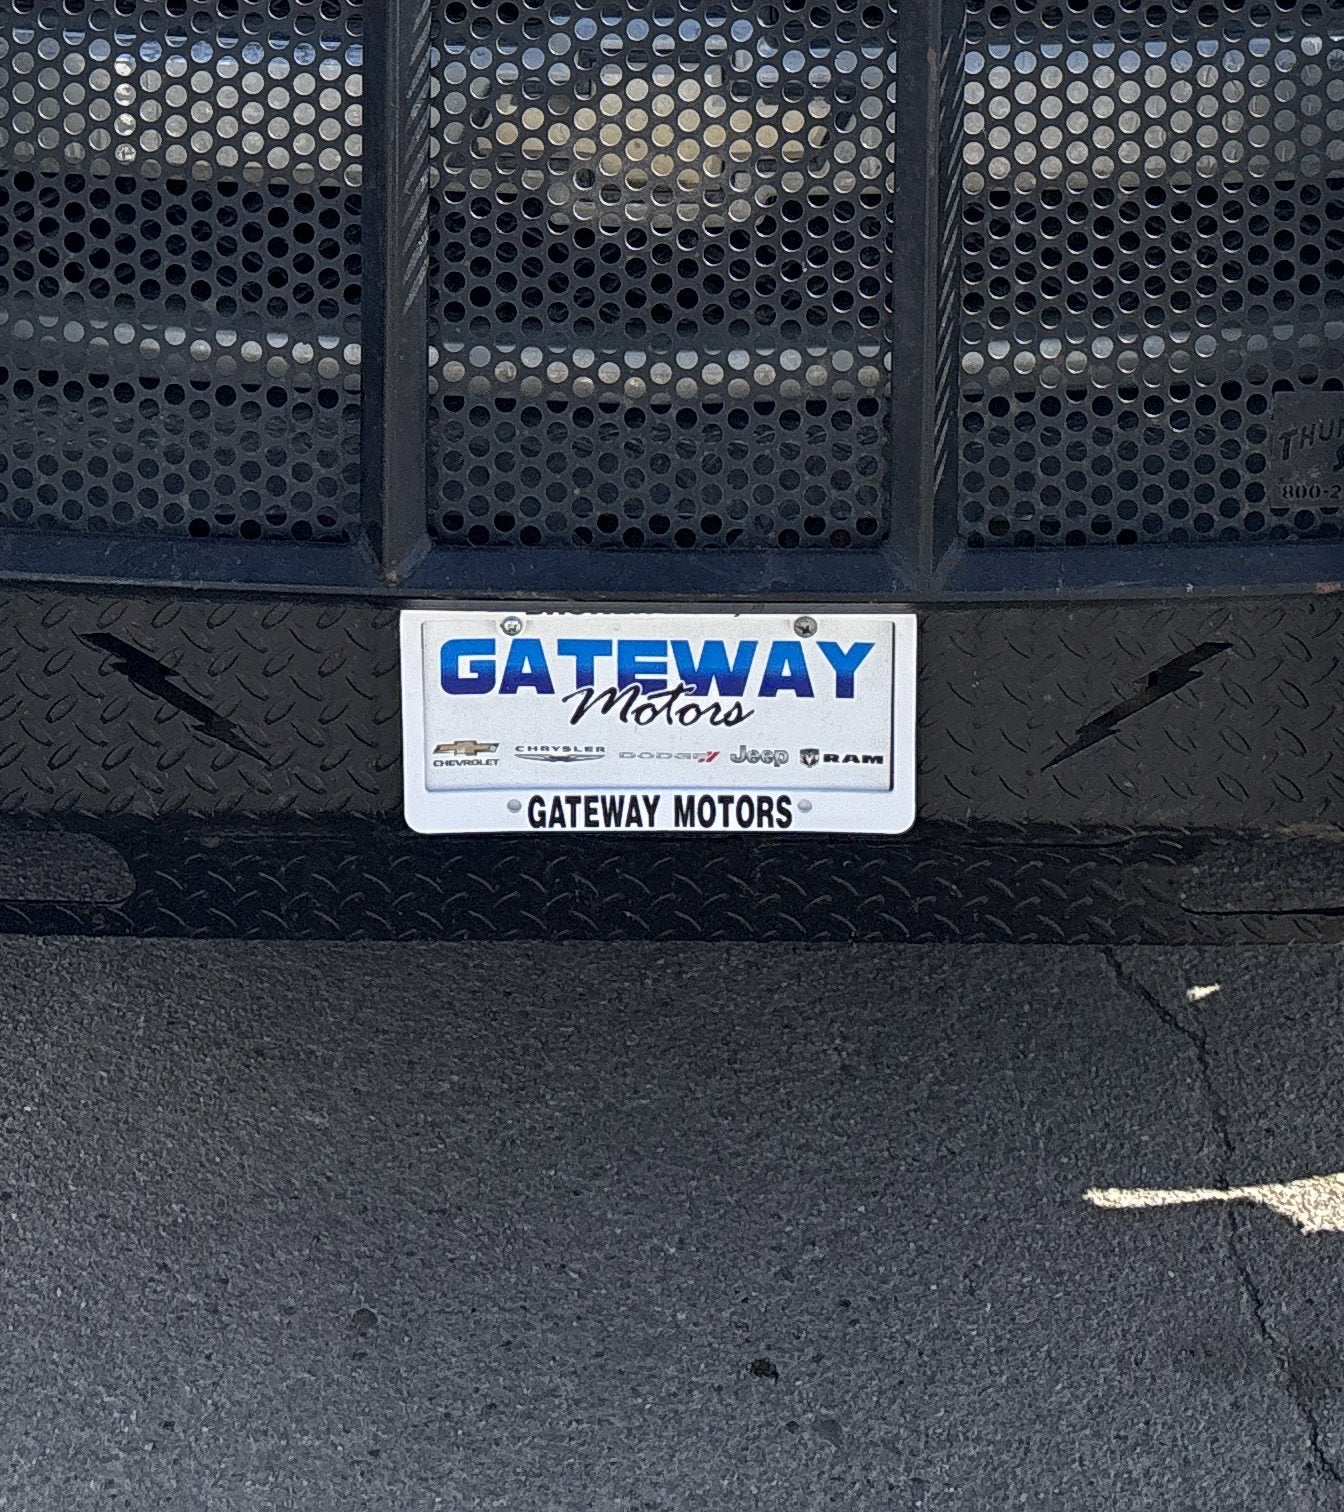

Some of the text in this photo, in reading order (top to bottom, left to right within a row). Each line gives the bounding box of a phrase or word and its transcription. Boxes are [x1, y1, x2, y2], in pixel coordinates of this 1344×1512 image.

[440, 637, 876, 699] GATEWAY
[561, 683, 755, 727] Motors
[514, 745, 606, 753] CHRYSLER
[729, 744, 790, 768] Jeep
[823, 753, 884, 765] RAM
[432, 758, 500, 768] CHEVROLET
[527, 794, 793, 829] GATEWAY MOTORS
